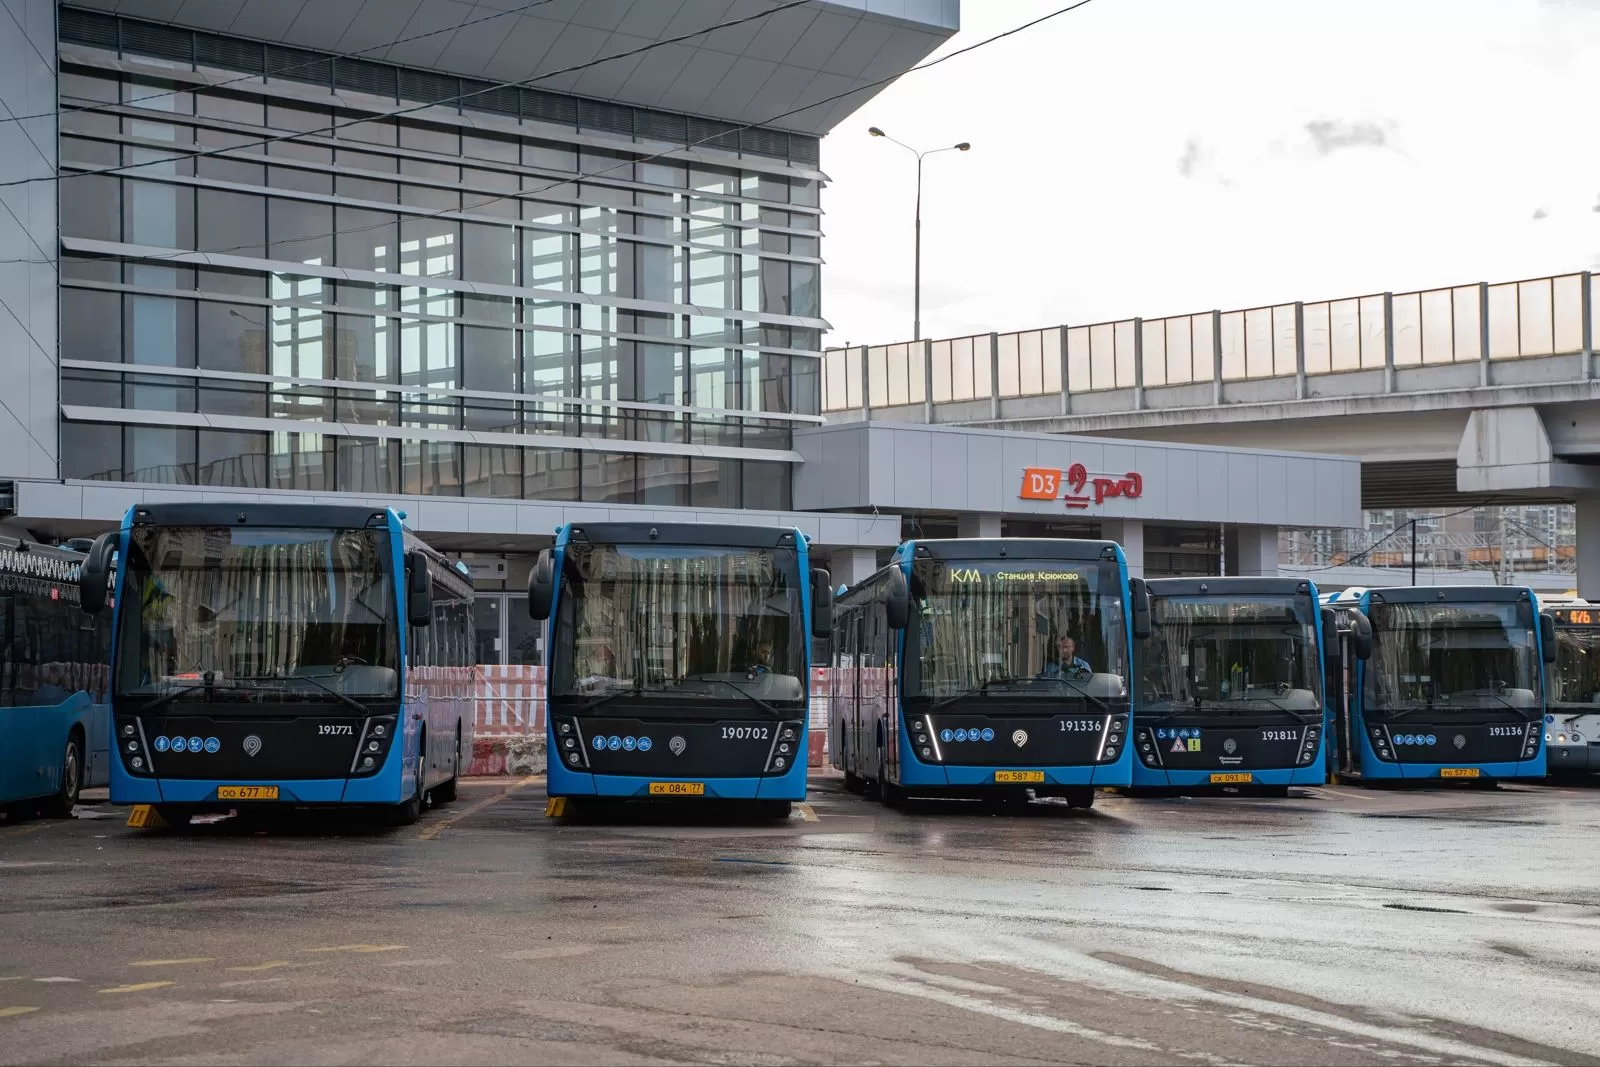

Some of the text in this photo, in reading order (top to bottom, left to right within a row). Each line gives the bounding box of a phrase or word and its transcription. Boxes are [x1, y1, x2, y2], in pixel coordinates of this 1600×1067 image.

[1031, 474, 1055, 494] D3
[997, 571, 1078, 581] Станция Крюково
[318, 725, 353, 736] 191771
[1060, 720, 1101, 732] 191336
[722, 727, 768, 740] 190702
[1262, 731, 1298, 741] 191811
[1489, 727, 1522, 736] 191136
[1012, 771, 1028, 781] 587
[1225, 774, 1239, 782] 093
[222, 789, 236, 798] ОО
[239, 787, 259, 798] 677
[653, 785, 665, 793] СК
[668, 783, 687, 793] 084
